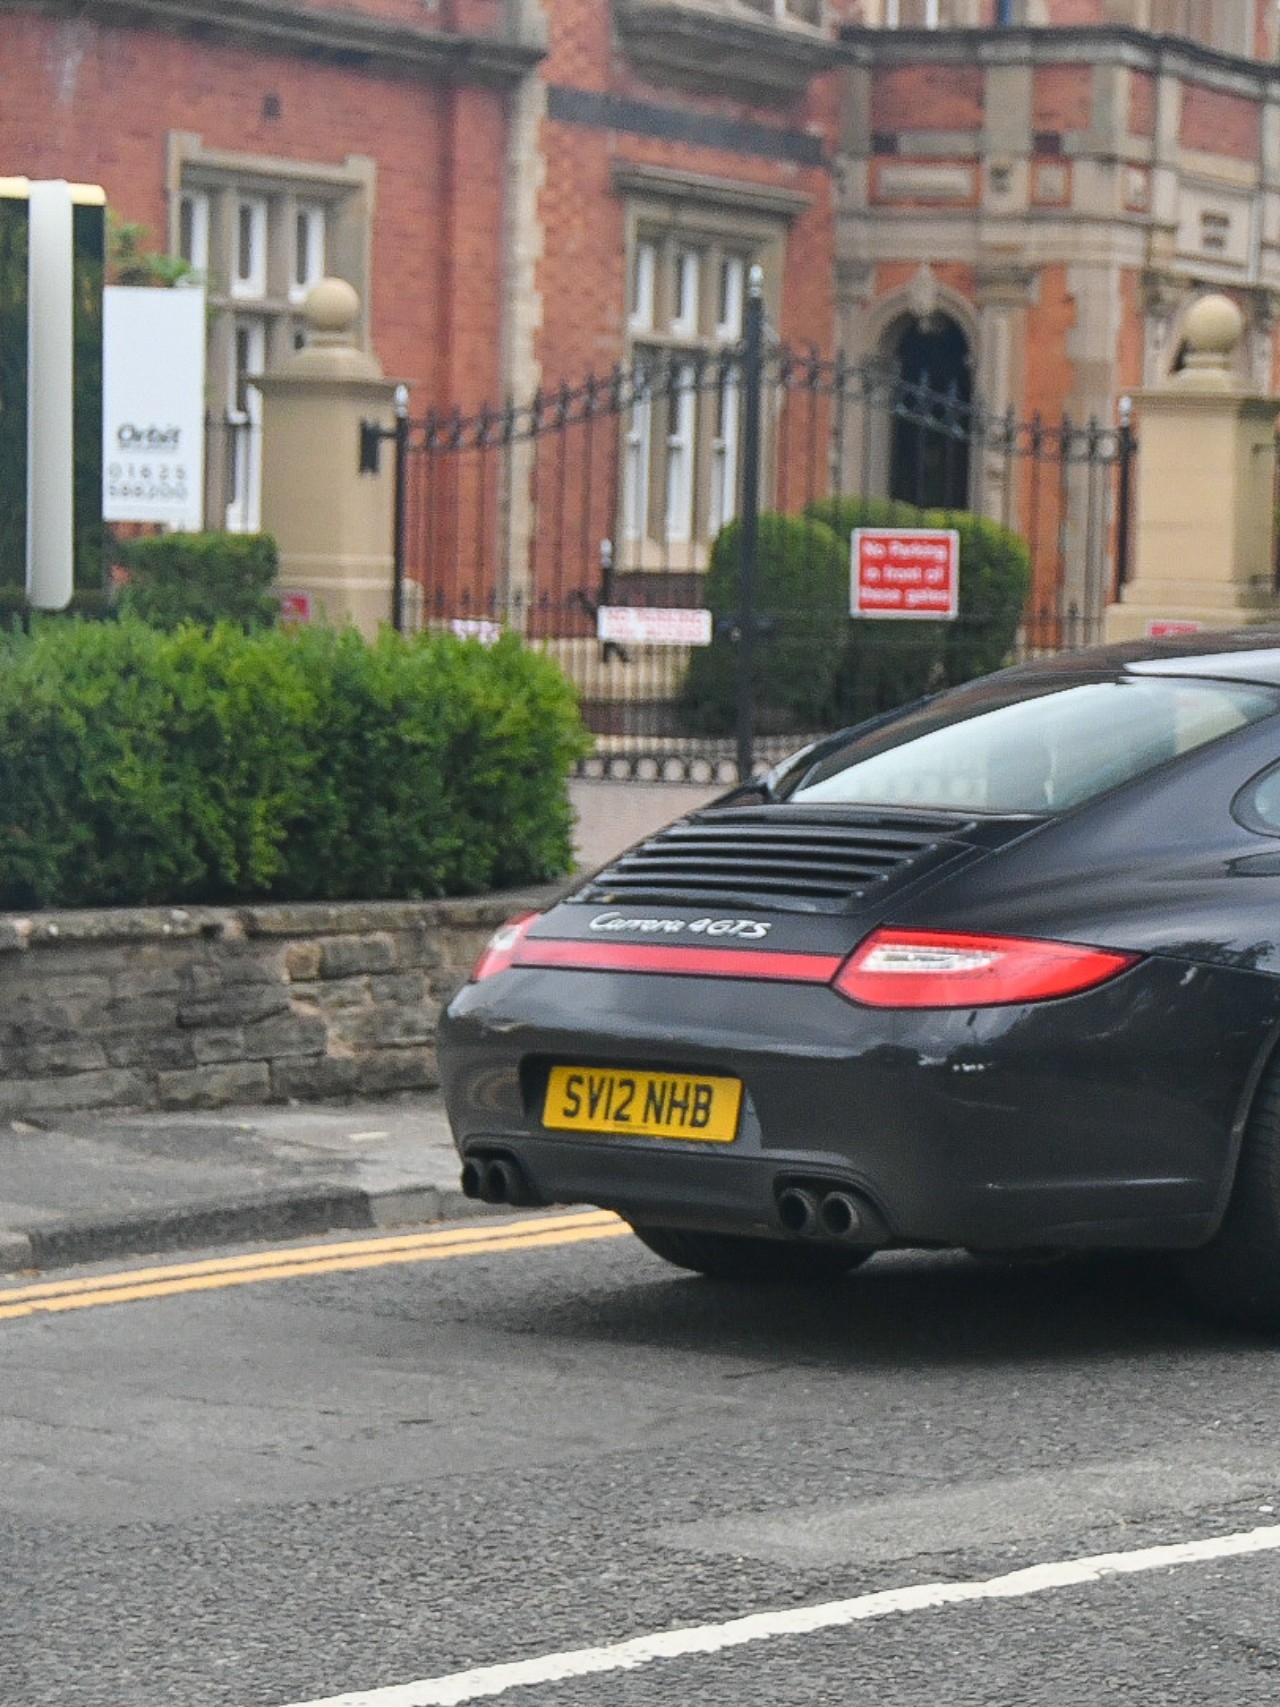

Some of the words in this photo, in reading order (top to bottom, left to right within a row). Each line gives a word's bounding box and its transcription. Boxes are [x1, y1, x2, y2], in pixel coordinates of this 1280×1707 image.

[588, 911, 686, 934] Carrera
[562, 1074, 636, 1123] SV12
[642, 1078, 714, 1128] NHB
